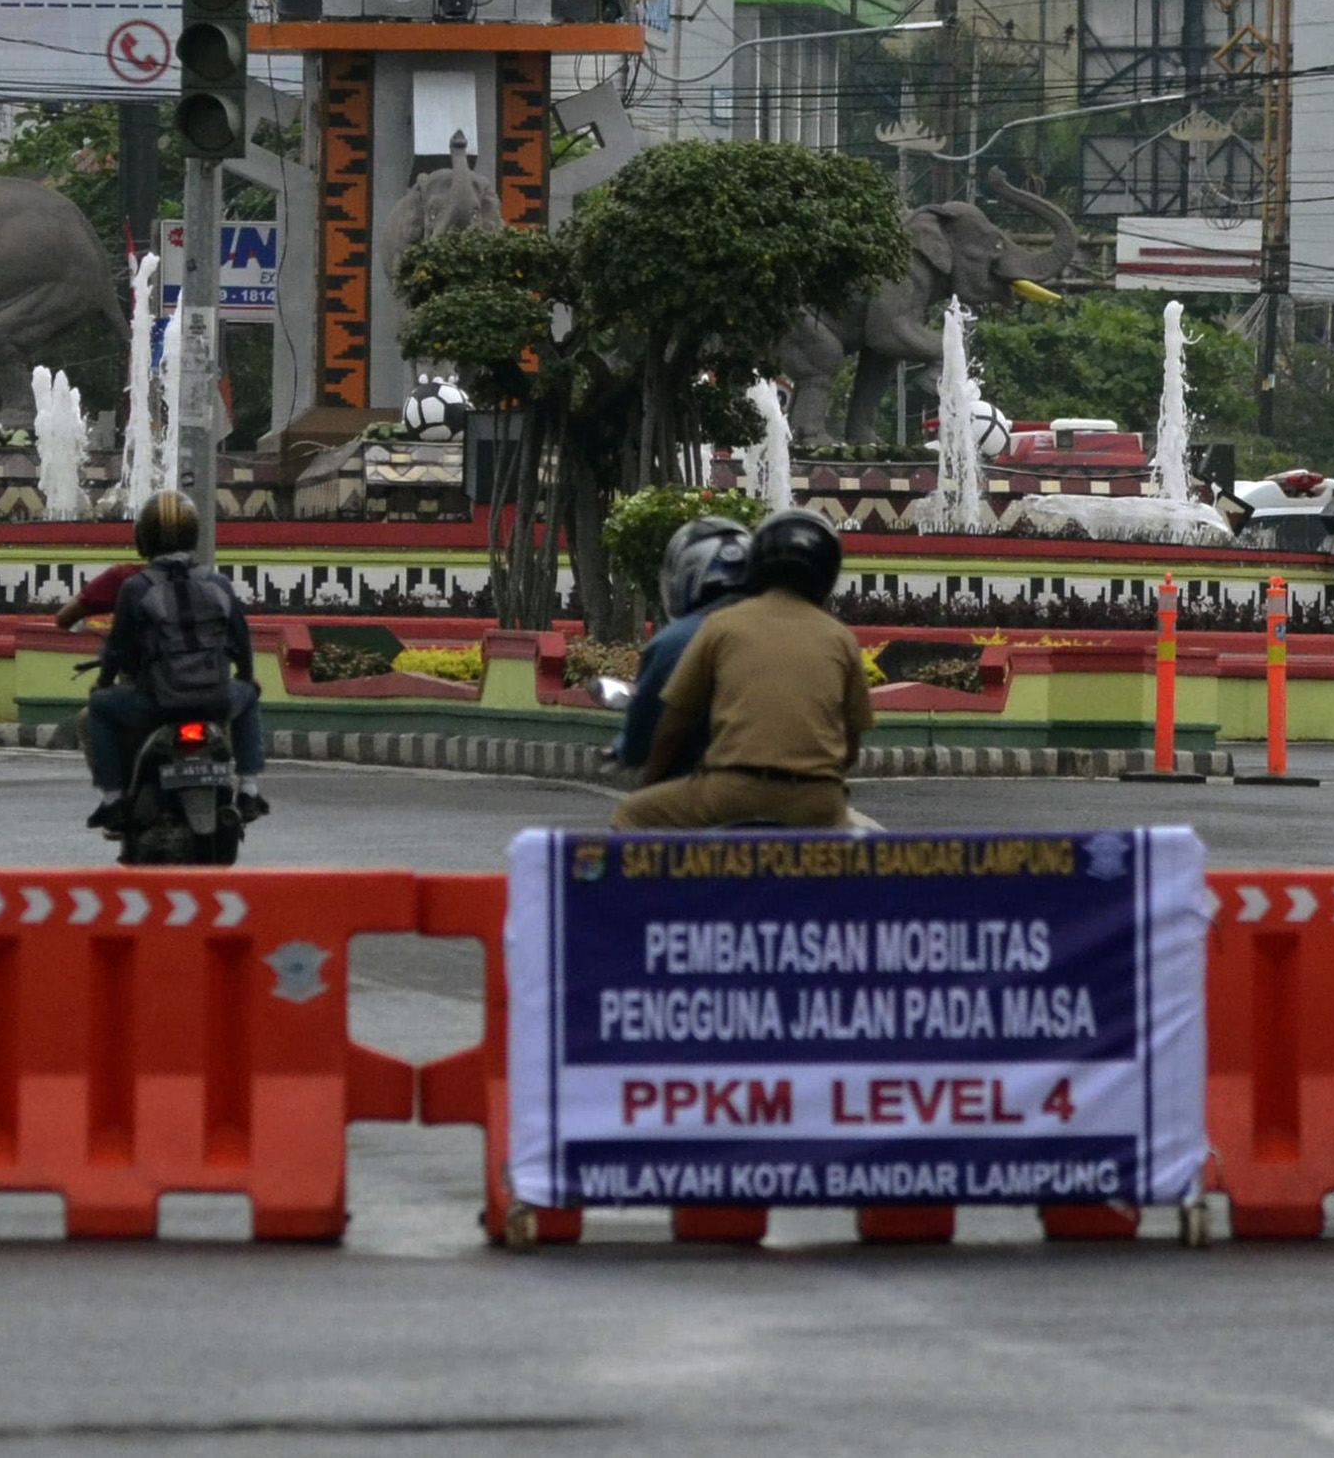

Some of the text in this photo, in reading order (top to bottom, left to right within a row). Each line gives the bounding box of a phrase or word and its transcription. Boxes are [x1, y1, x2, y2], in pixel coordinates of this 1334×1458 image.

[242, 290, 275, 302] 1814
[621, 840, 1074, 877] SAT LANTAS POLRESTA BANDAR LAMPUNG
[645, 919, 1050, 975] PEMBATASAN MOBILITAS
[600, 984, 1097, 1041] PENGGUNA JALAN PADA MASA
[620, 1076, 1075, 1126] PPKM LEVEL 4
[580, 1160, 1118, 1198] WILAYAH KOTA BANDAR LAMPUNG
